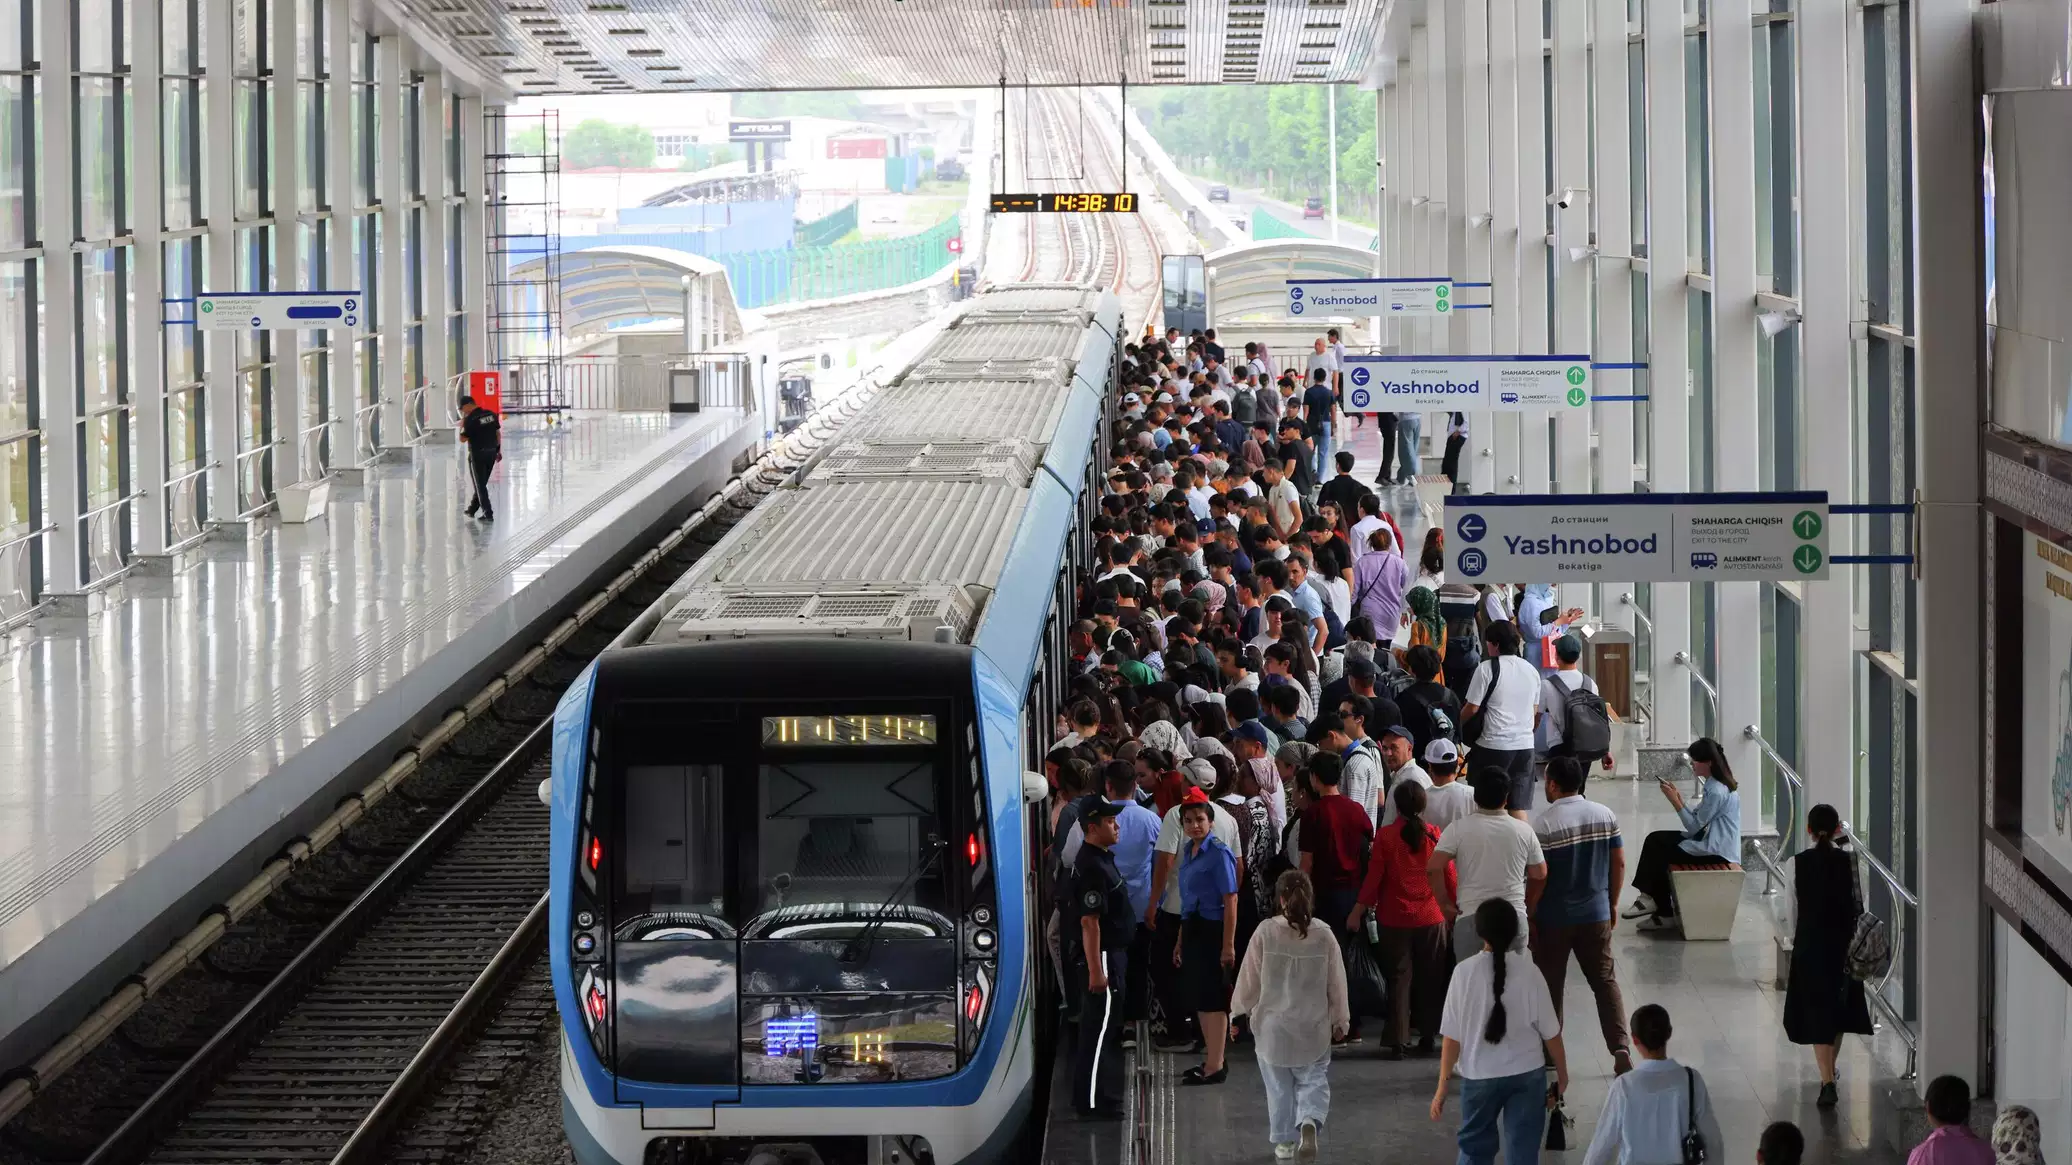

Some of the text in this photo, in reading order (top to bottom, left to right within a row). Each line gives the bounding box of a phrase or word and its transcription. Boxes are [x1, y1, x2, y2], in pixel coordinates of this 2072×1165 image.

[1054, 195, 1132, 211] 14:38:10
[1310, 295, 1377, 305] Yashnobod
[1380, 380, 1479, 394] Yashnobod
[1551, 516, 1609, 524] До станции
[1691, 517, 1783, 526] SHAHARGA CHIQISH
[1503, 533, 1657, 555] Yashnobod
[1558, 563, 1602, 571] Bekatiga
